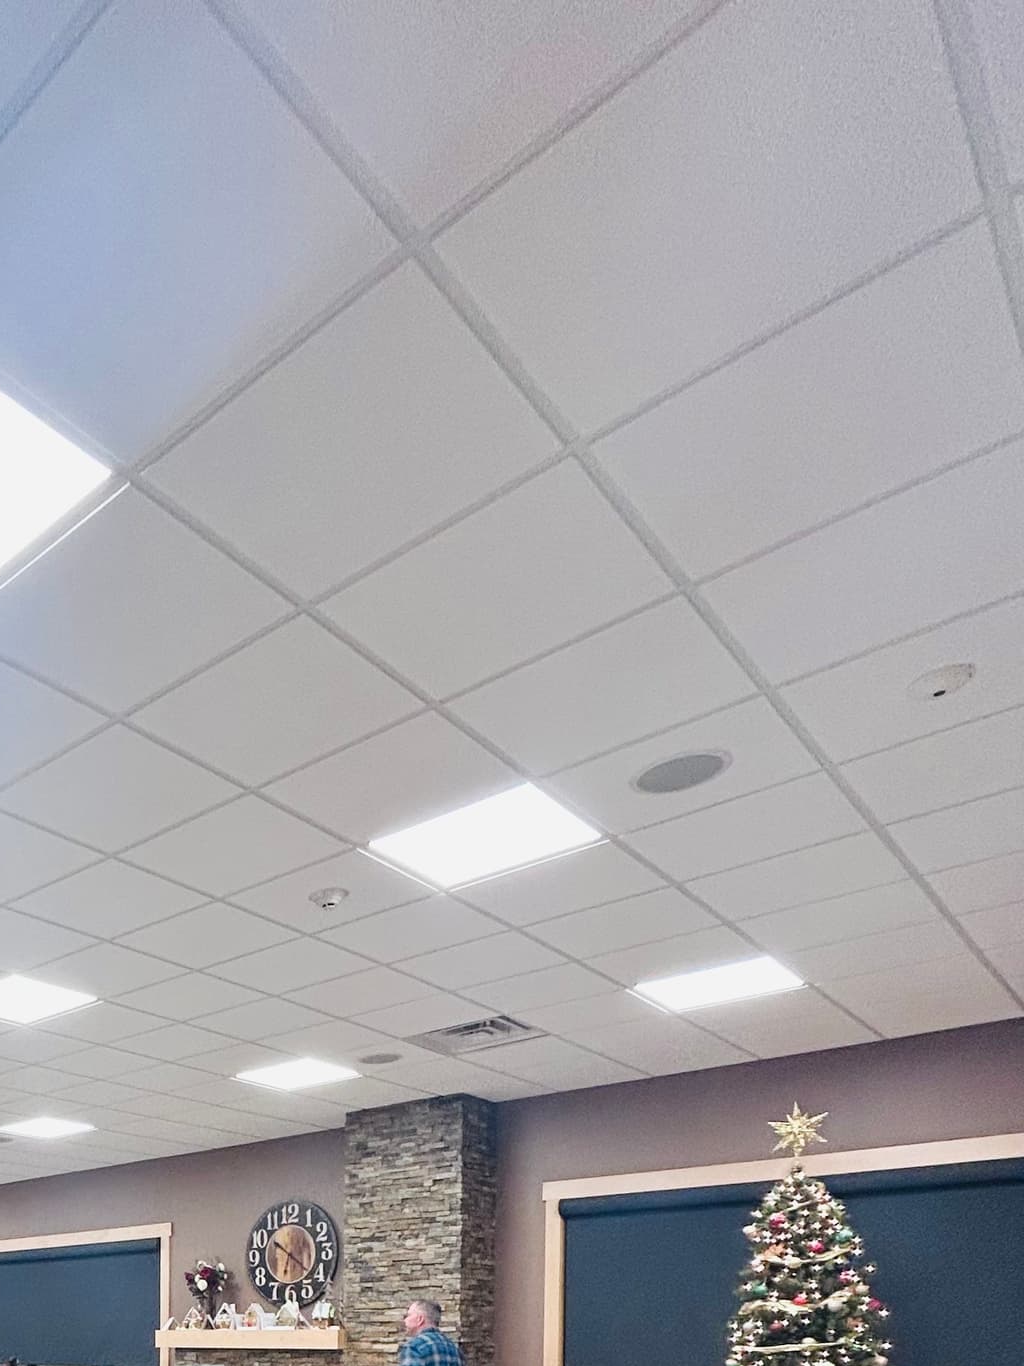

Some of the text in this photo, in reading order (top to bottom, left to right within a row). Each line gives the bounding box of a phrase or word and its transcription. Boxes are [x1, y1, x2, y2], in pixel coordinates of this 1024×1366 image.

[267, 1211, 279, 1230] 11
[281, 1204, 299, 1224] 12
[305, 1208, 313, 1227] 1
[252, 1229, 268, 1248] 10
[316, 1221, 328, 1242] 2
[249, 1250, 260, 1267] 9
[321, 1242, 333, 1261] 3
[255, 1267, 266, 1287] 8
[314, 1262, 325, 1282] 4
[269, 1282, 280, 1301] 7
[285, 1284, 297, 1303] 6
[301, 1279, 314, 1299] 5
